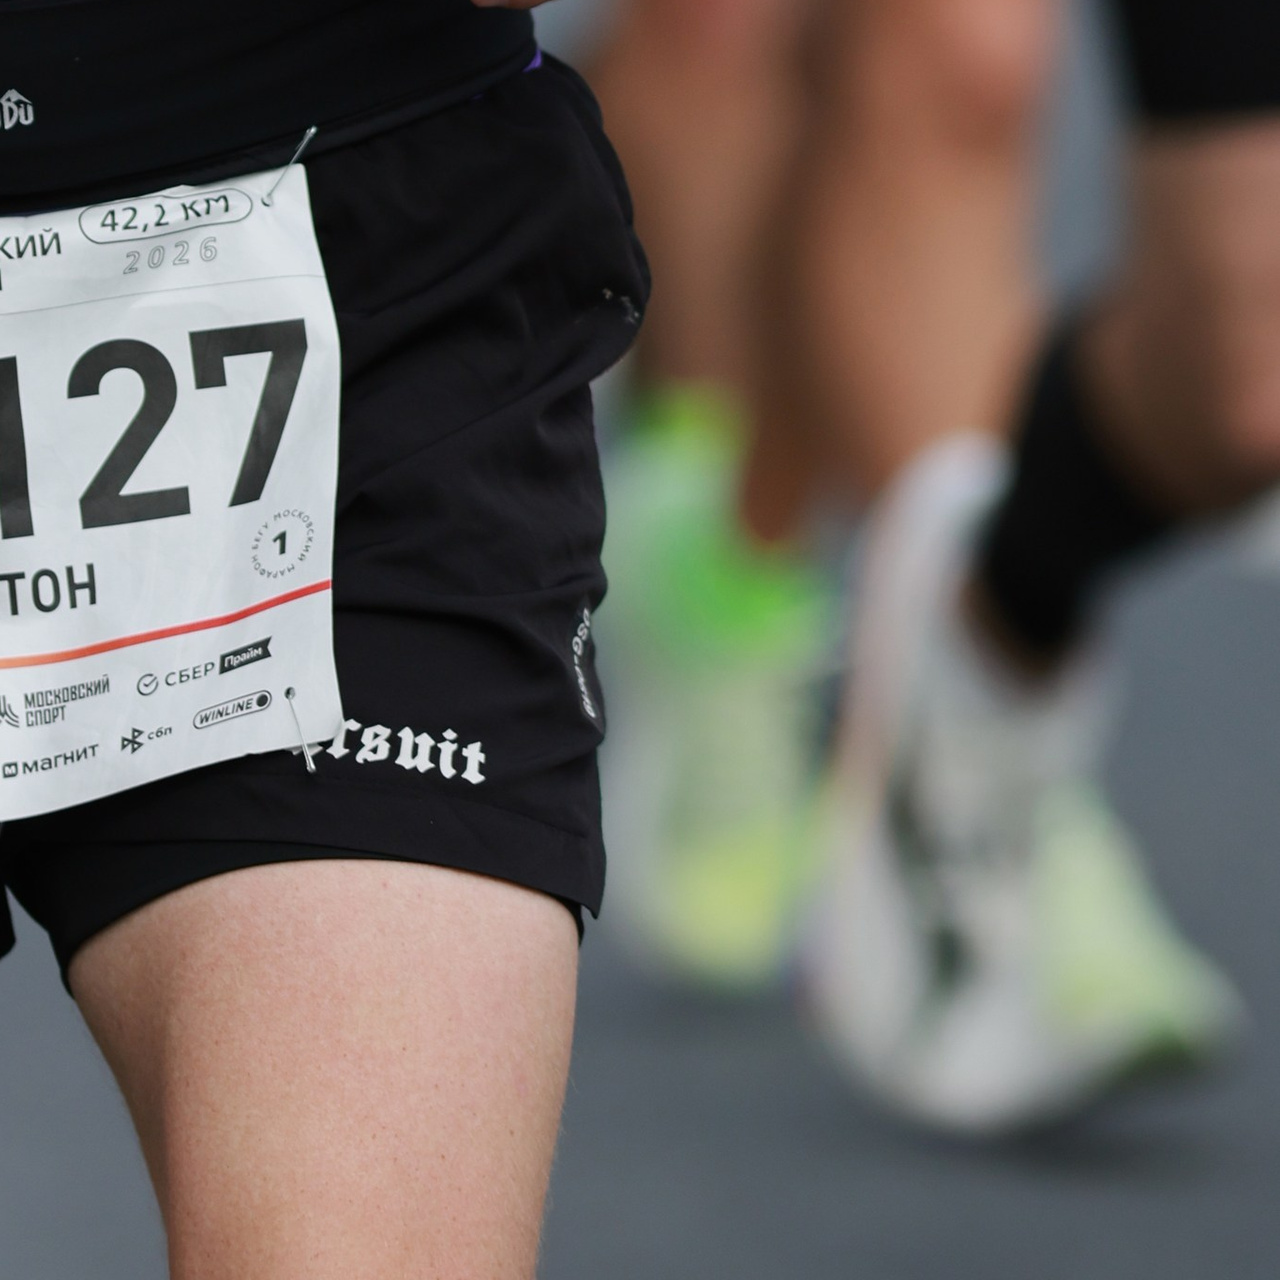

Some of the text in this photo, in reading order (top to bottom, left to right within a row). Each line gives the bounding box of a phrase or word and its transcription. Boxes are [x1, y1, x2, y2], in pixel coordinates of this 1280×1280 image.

[100, 204, 169, 233] 42,2
[122, 237, 218, 275] 2026
[272, 530, 287, 556] 1
[164, 646, 263, 687] СБЕР Прайм
[23, 674, 110, 710] МОСКОВСКИЙ
[25, 704, 66, 727] СПОРТ
[199, 697, 254, 725] WINLINE
[286, 718, 487, 784] rsuit
